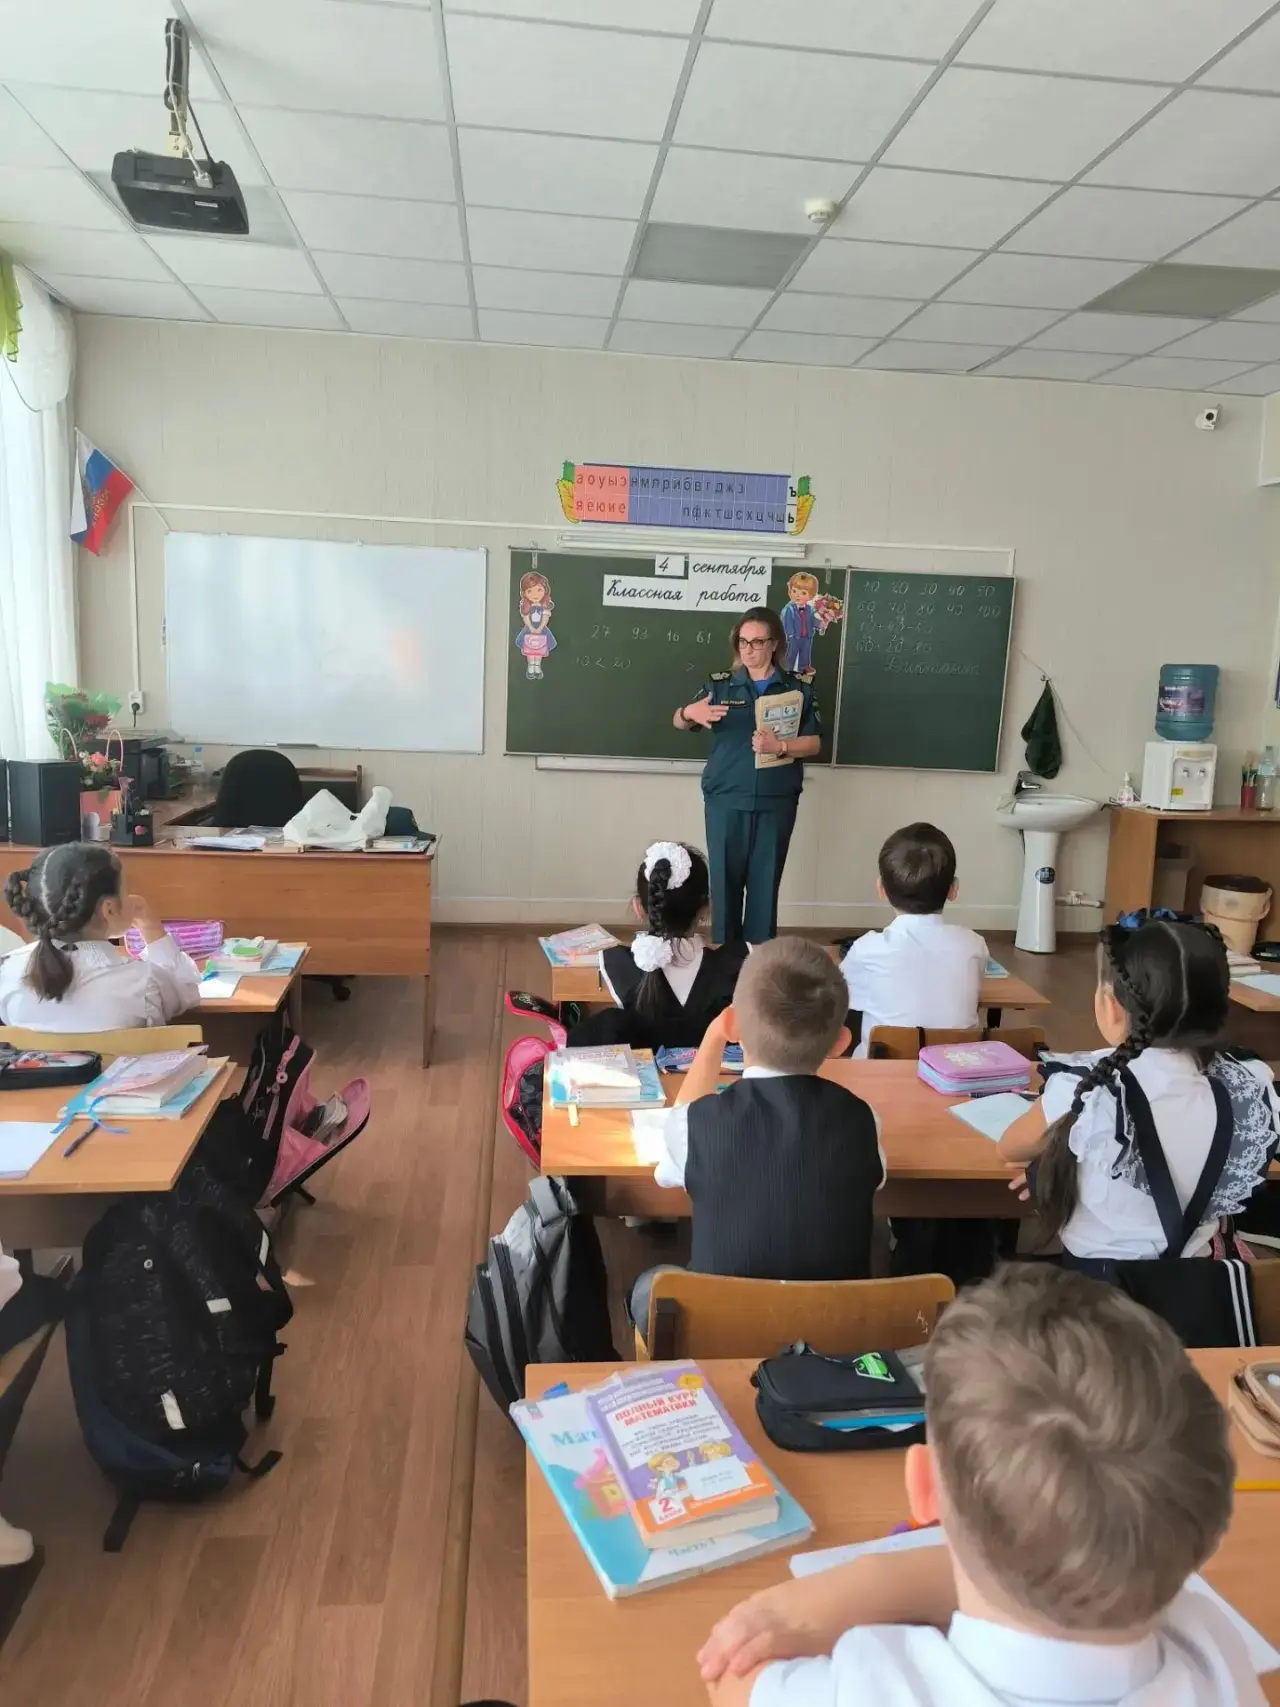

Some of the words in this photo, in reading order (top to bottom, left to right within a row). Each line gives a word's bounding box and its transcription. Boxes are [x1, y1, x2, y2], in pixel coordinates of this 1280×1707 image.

[658, 557, 670, 572] 4
[692, 557, 767, 581] сентября
[606, 579, 684, 601] Классная
[695, 583, 762, 607] работа
[615, 1397, 665, 1421] ПОЛНЫЙ
[624, 1400, 697, 1426] МАТЕМАТИКИ
[659, 1497, 672, 1512] 2
